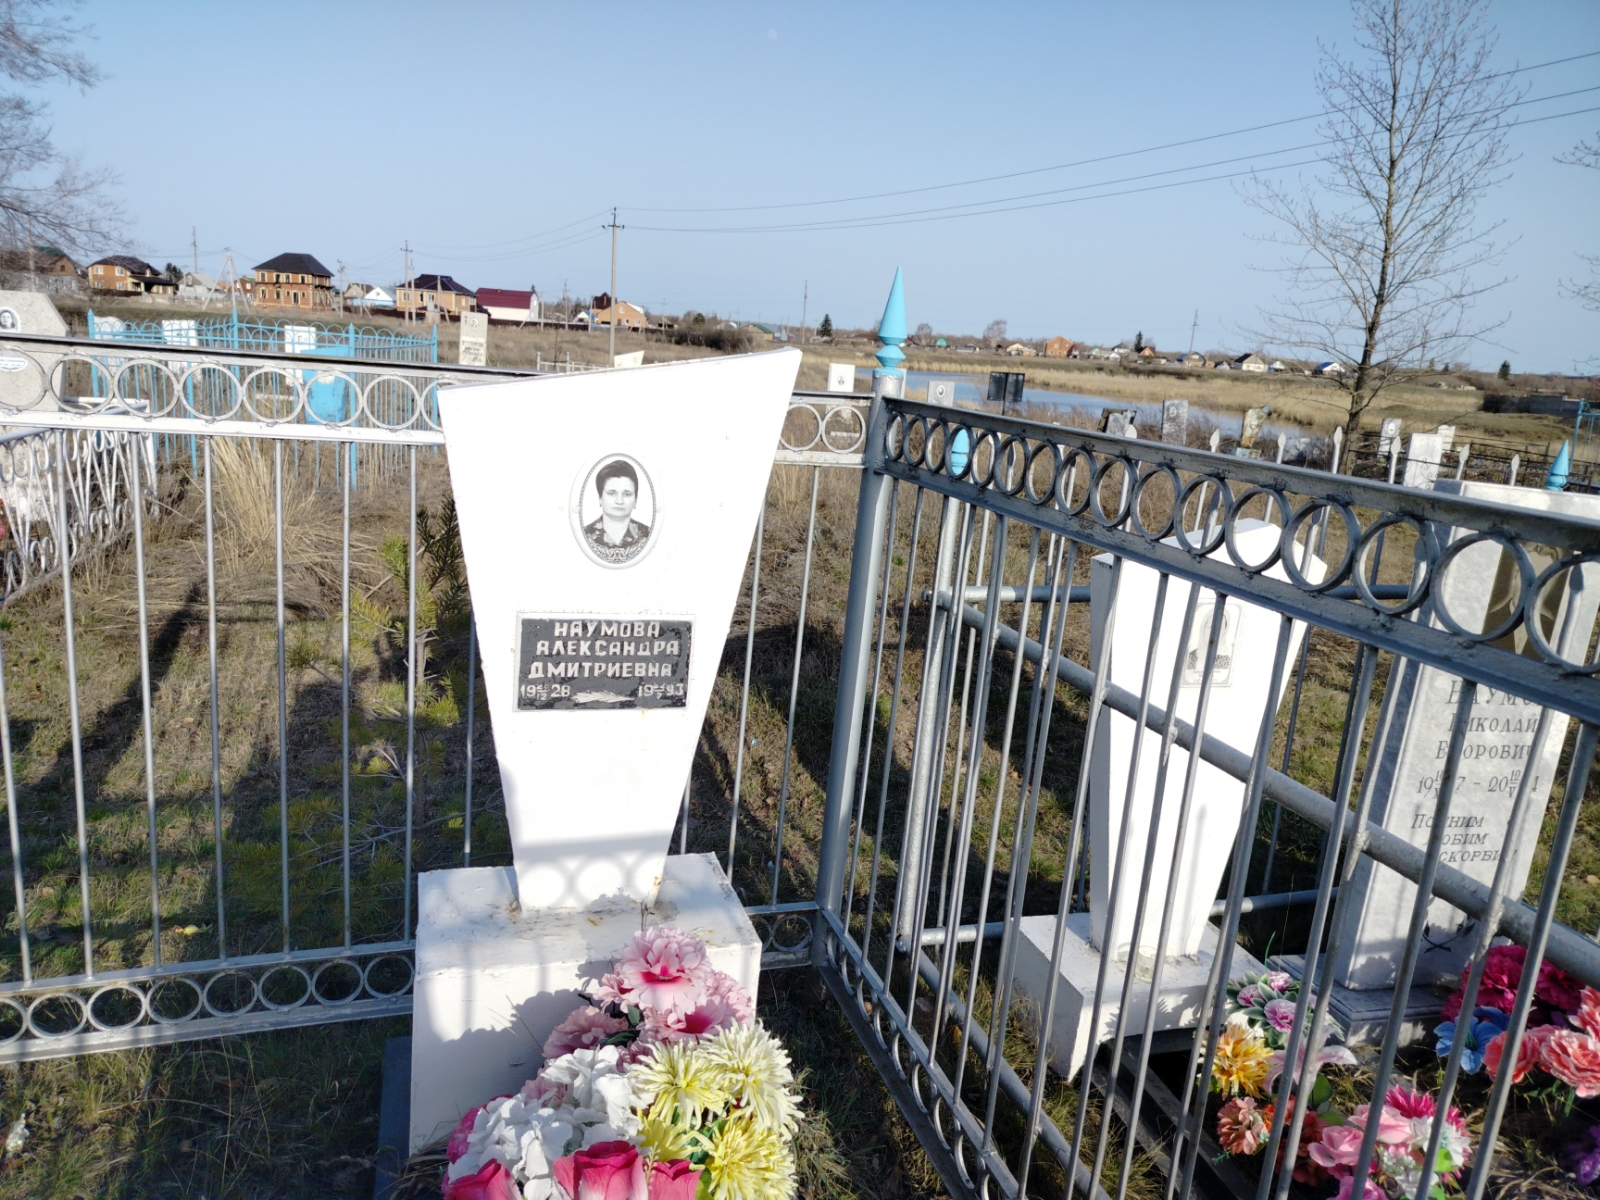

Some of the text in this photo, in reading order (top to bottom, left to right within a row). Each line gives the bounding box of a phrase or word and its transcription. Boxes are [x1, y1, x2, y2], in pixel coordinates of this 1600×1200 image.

[554, 620, 661, 638] НАУМОВА
[535, 640, 680, 657] АЛЕКСАНДРА
[527, 661, 673, 679] ДМИТРИЕВНА
